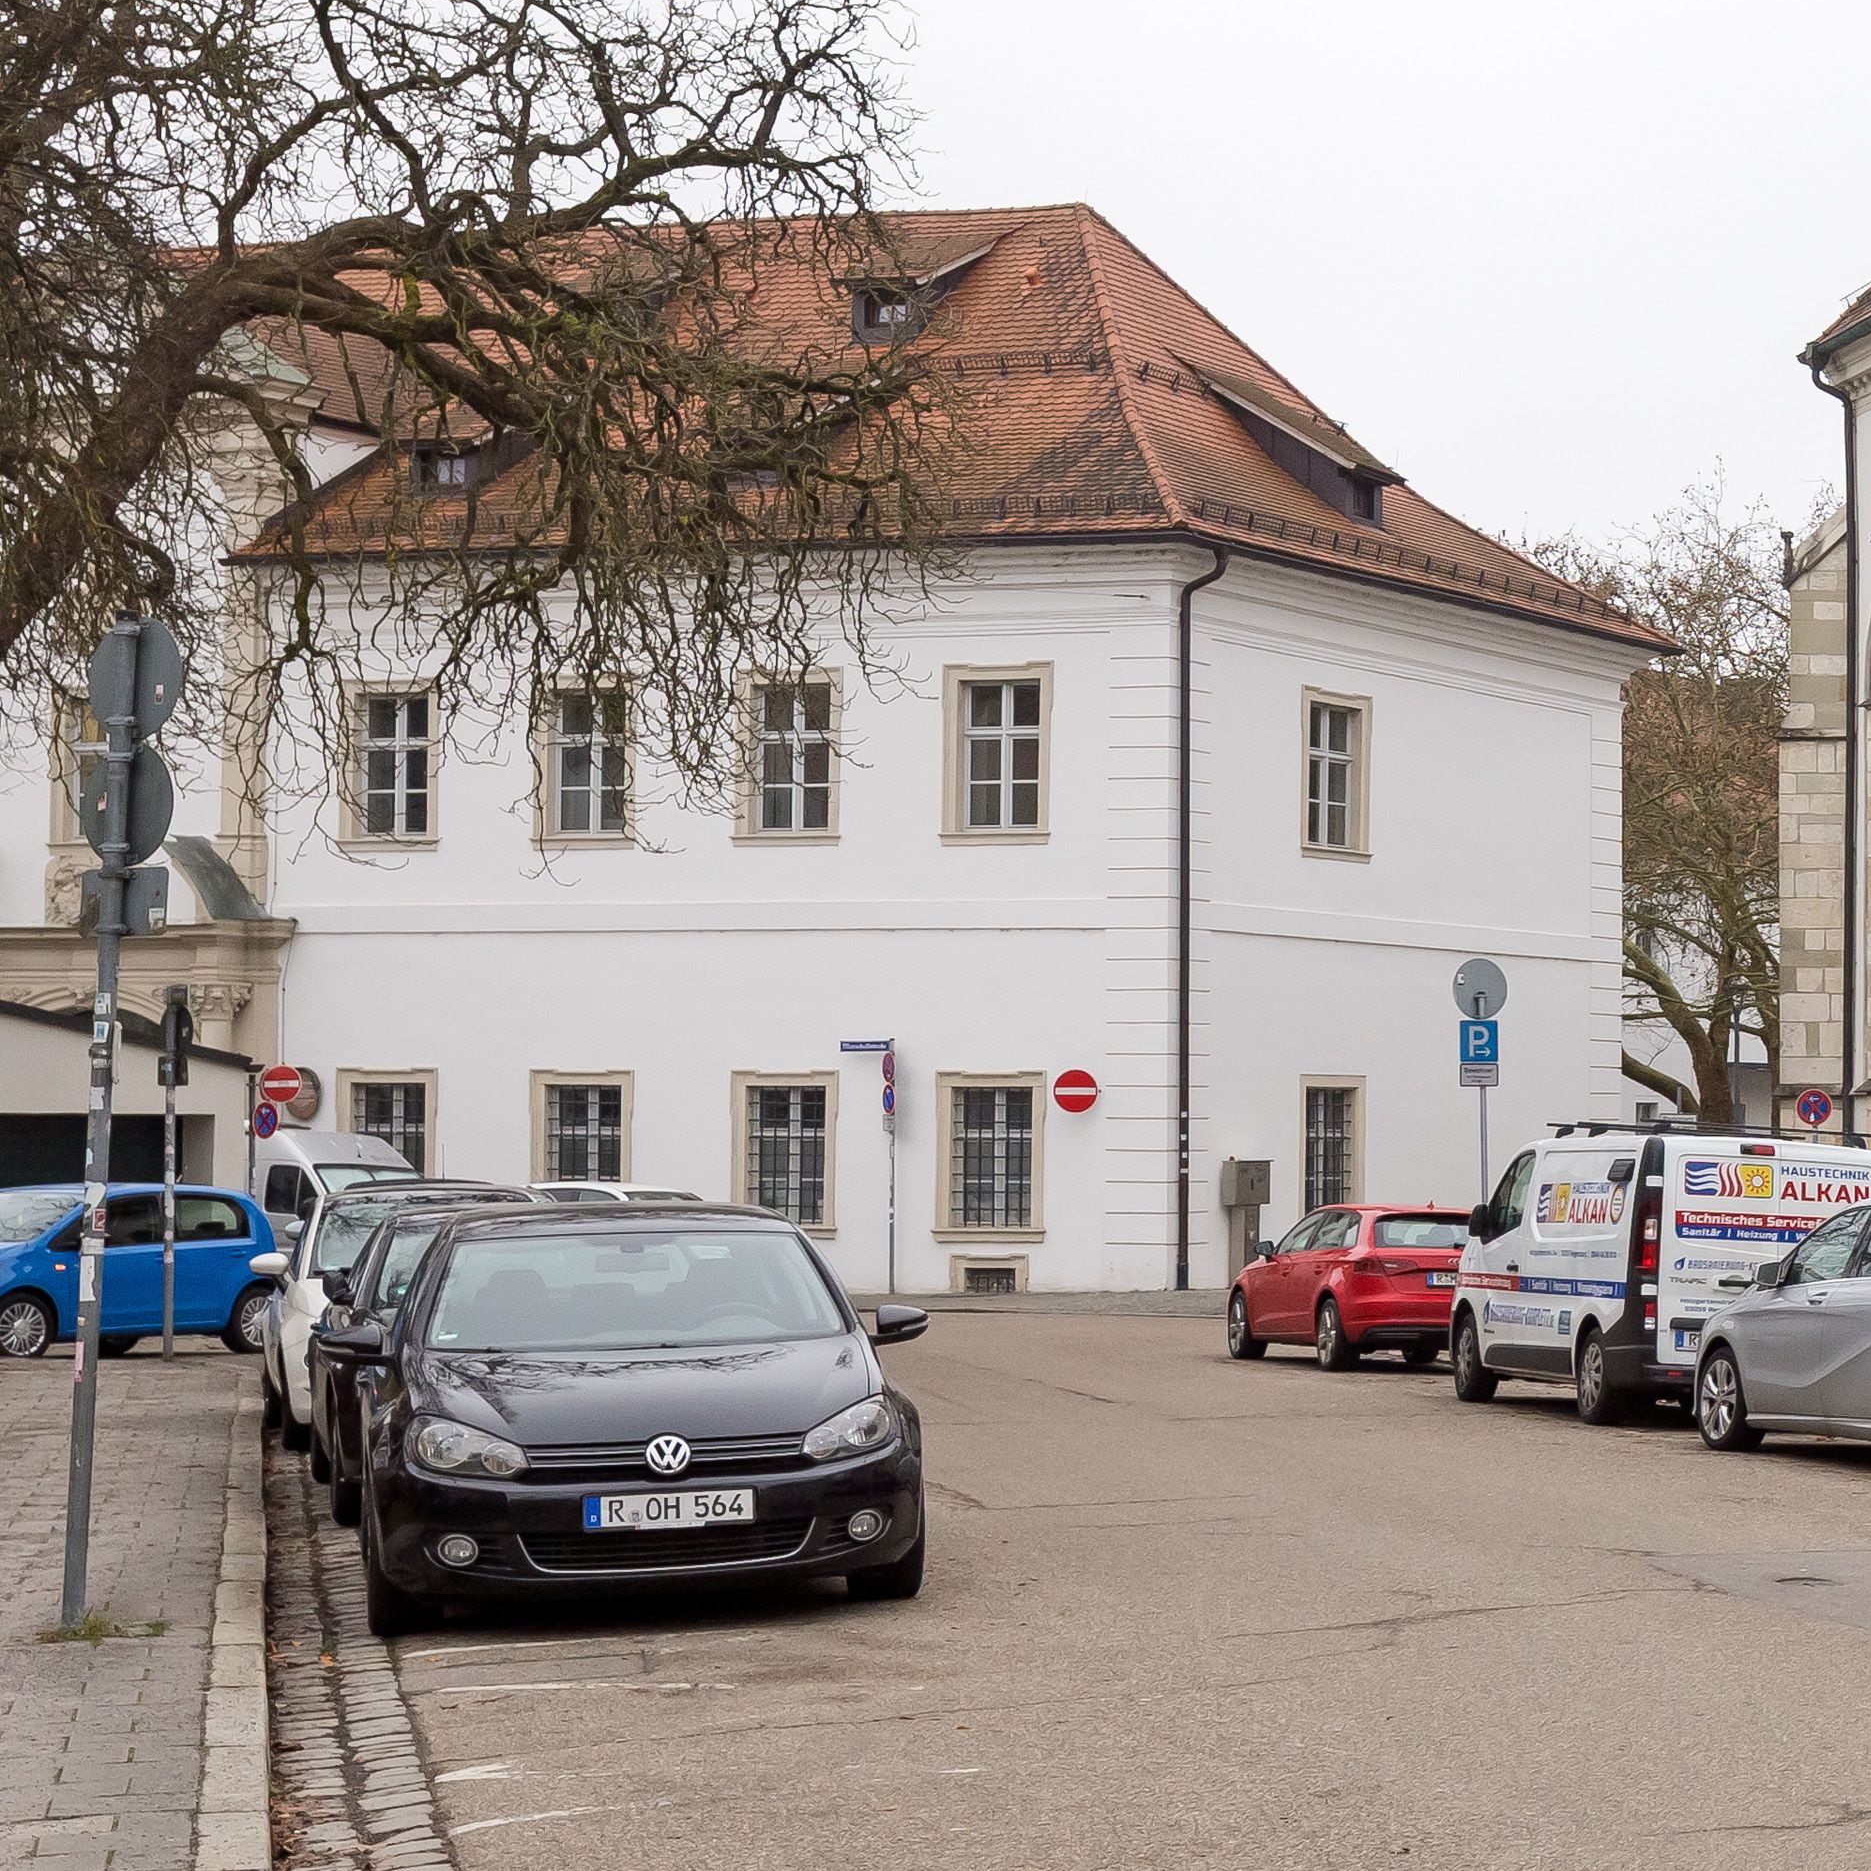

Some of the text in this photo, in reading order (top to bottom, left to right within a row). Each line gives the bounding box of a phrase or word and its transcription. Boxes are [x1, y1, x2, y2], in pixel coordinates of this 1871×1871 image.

[1468, 1025, 1490, 1057] P
[1780, 1165, 1871, 1181] HAUSTECHNIK
[1780, 1181, 1871, 1204] ALKAN
[1567, 1198, 1609, 1224] ALKAN
[1680, 1211, 1764, 1228] Technisches
[1681, 1226, 1779, 1242] Sanitär Heizung
[1688, 1333, 1697, 1346] R
[608, 1499, 626, 1523] R
[645, 1496, 681, 1521] OH
[694, 1493, 744, 1518] 564
